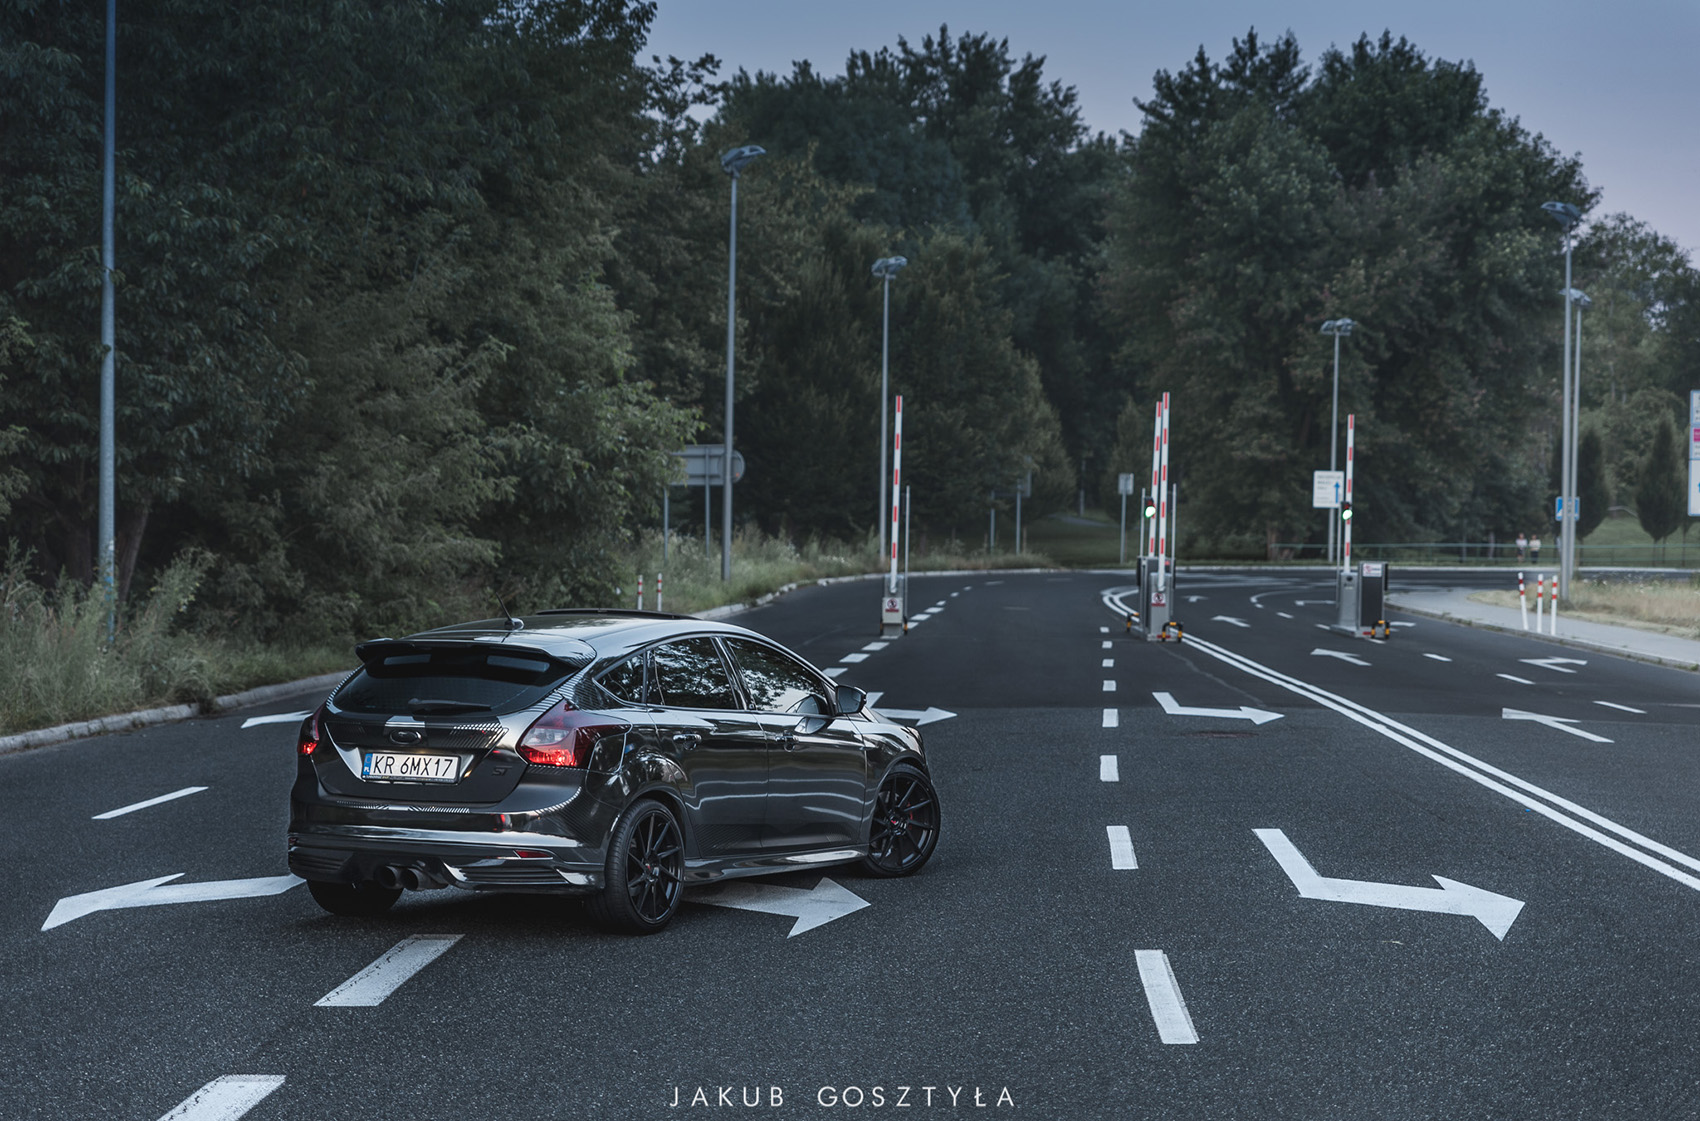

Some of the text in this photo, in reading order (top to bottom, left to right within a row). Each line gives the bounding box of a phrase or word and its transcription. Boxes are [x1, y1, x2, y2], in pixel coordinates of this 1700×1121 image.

[373, 756, 453, 776] KR 6MX17
[492, 766, 510, 777] ST
